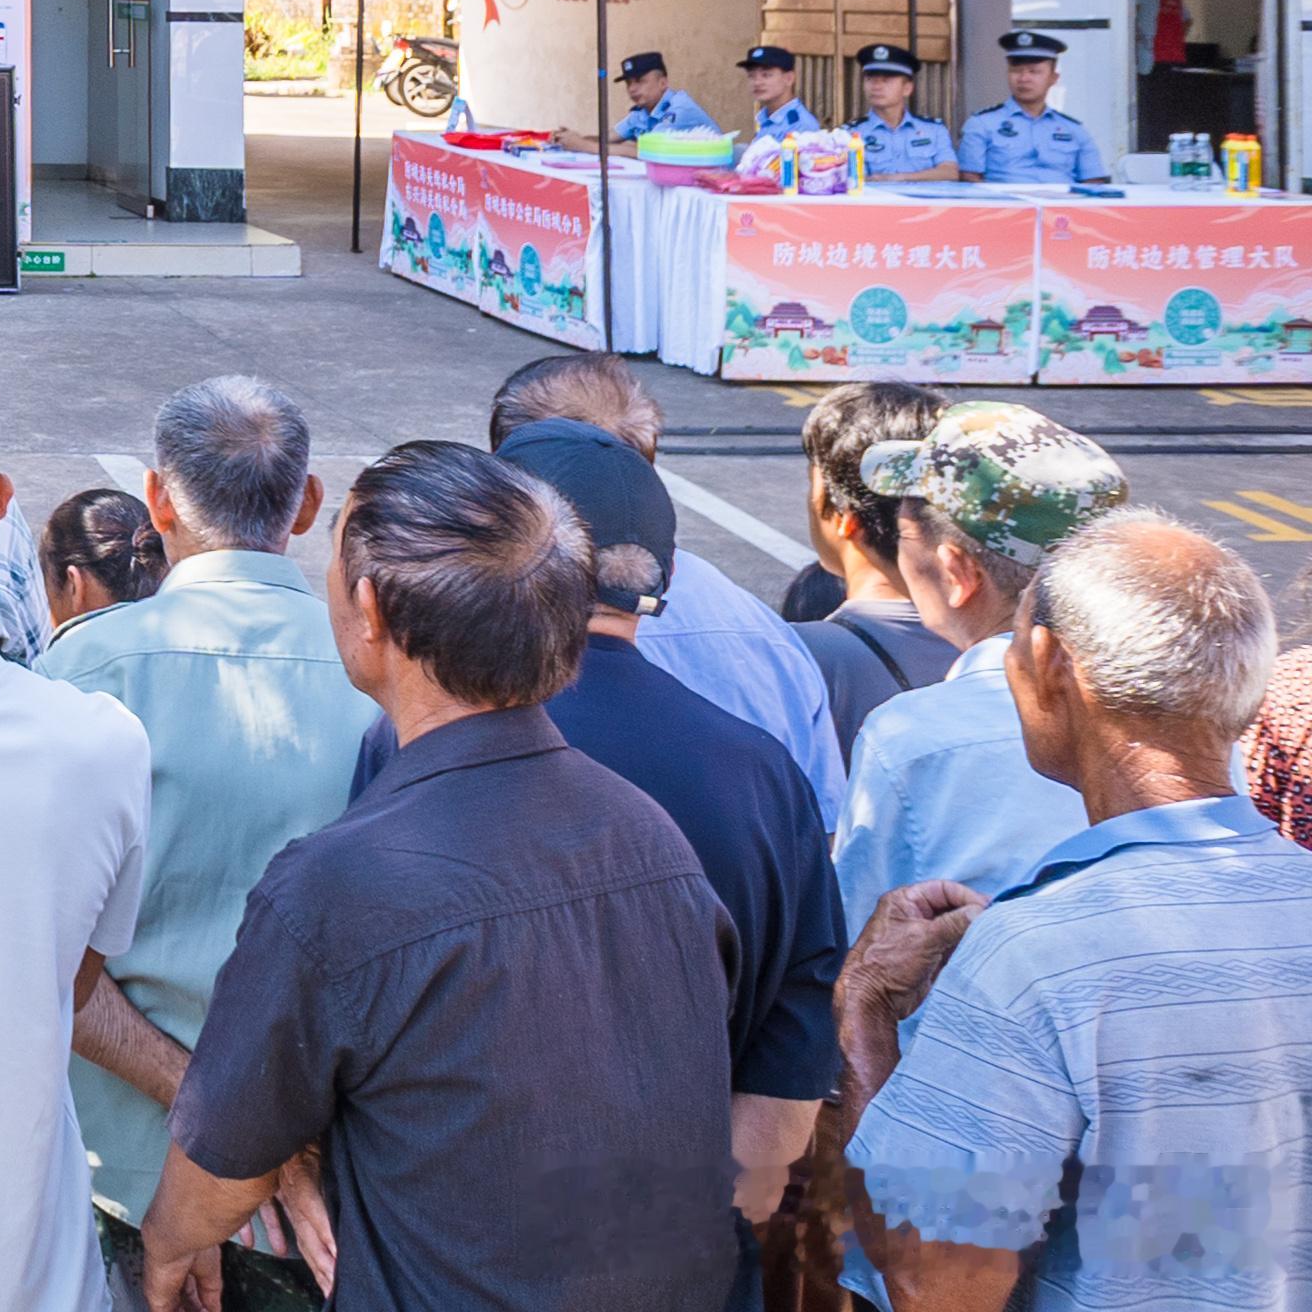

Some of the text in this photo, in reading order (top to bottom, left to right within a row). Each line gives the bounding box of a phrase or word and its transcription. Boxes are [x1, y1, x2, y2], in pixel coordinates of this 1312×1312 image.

[772, 241, 987, 270] 防城边境管理大队
[1086, 244, 1299, 271] 防城边境管理大队
